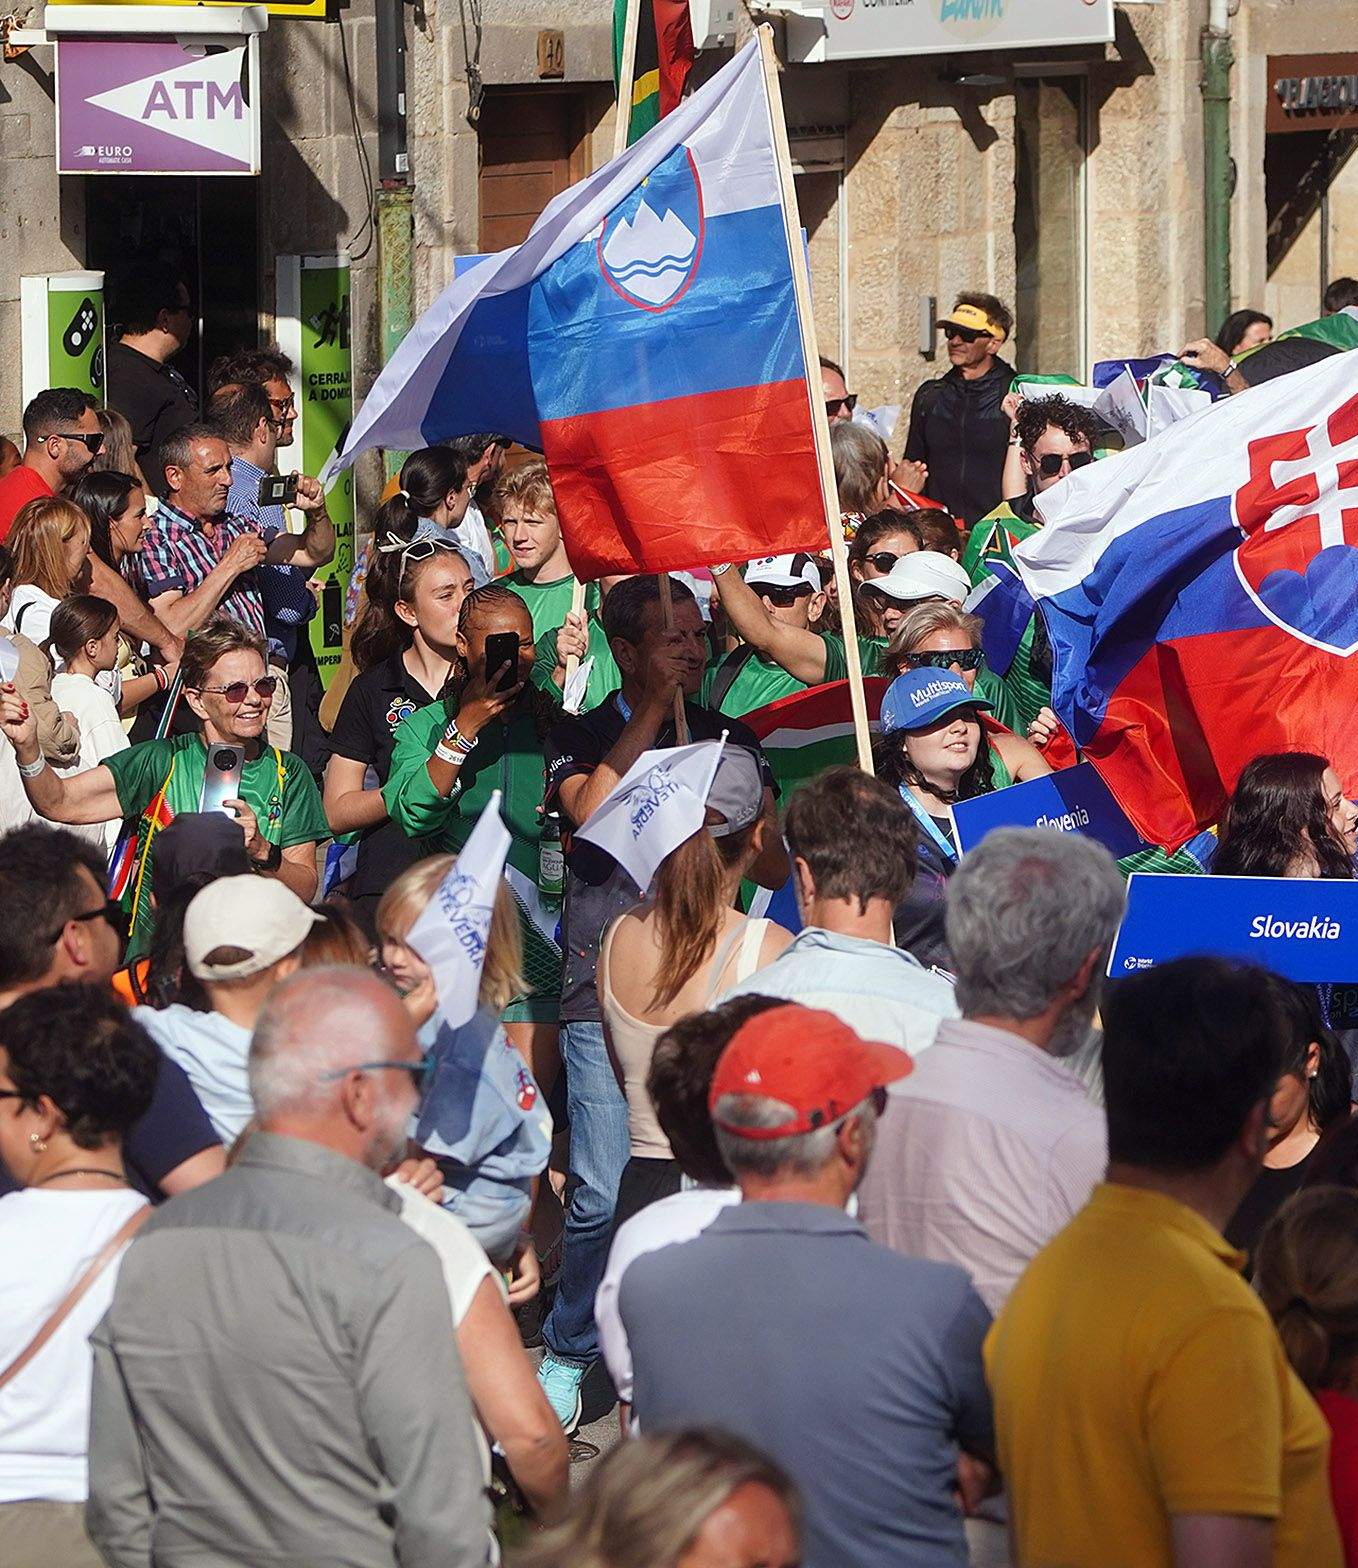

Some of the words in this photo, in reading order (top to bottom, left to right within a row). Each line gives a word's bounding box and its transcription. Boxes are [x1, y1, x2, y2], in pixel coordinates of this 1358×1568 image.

[141, 80, 243, 119] ATM
[98, 146, 132, 156] EURO
[308, 390, 317, 401] A
[1249, 914, 1341, 940] Slovakia
